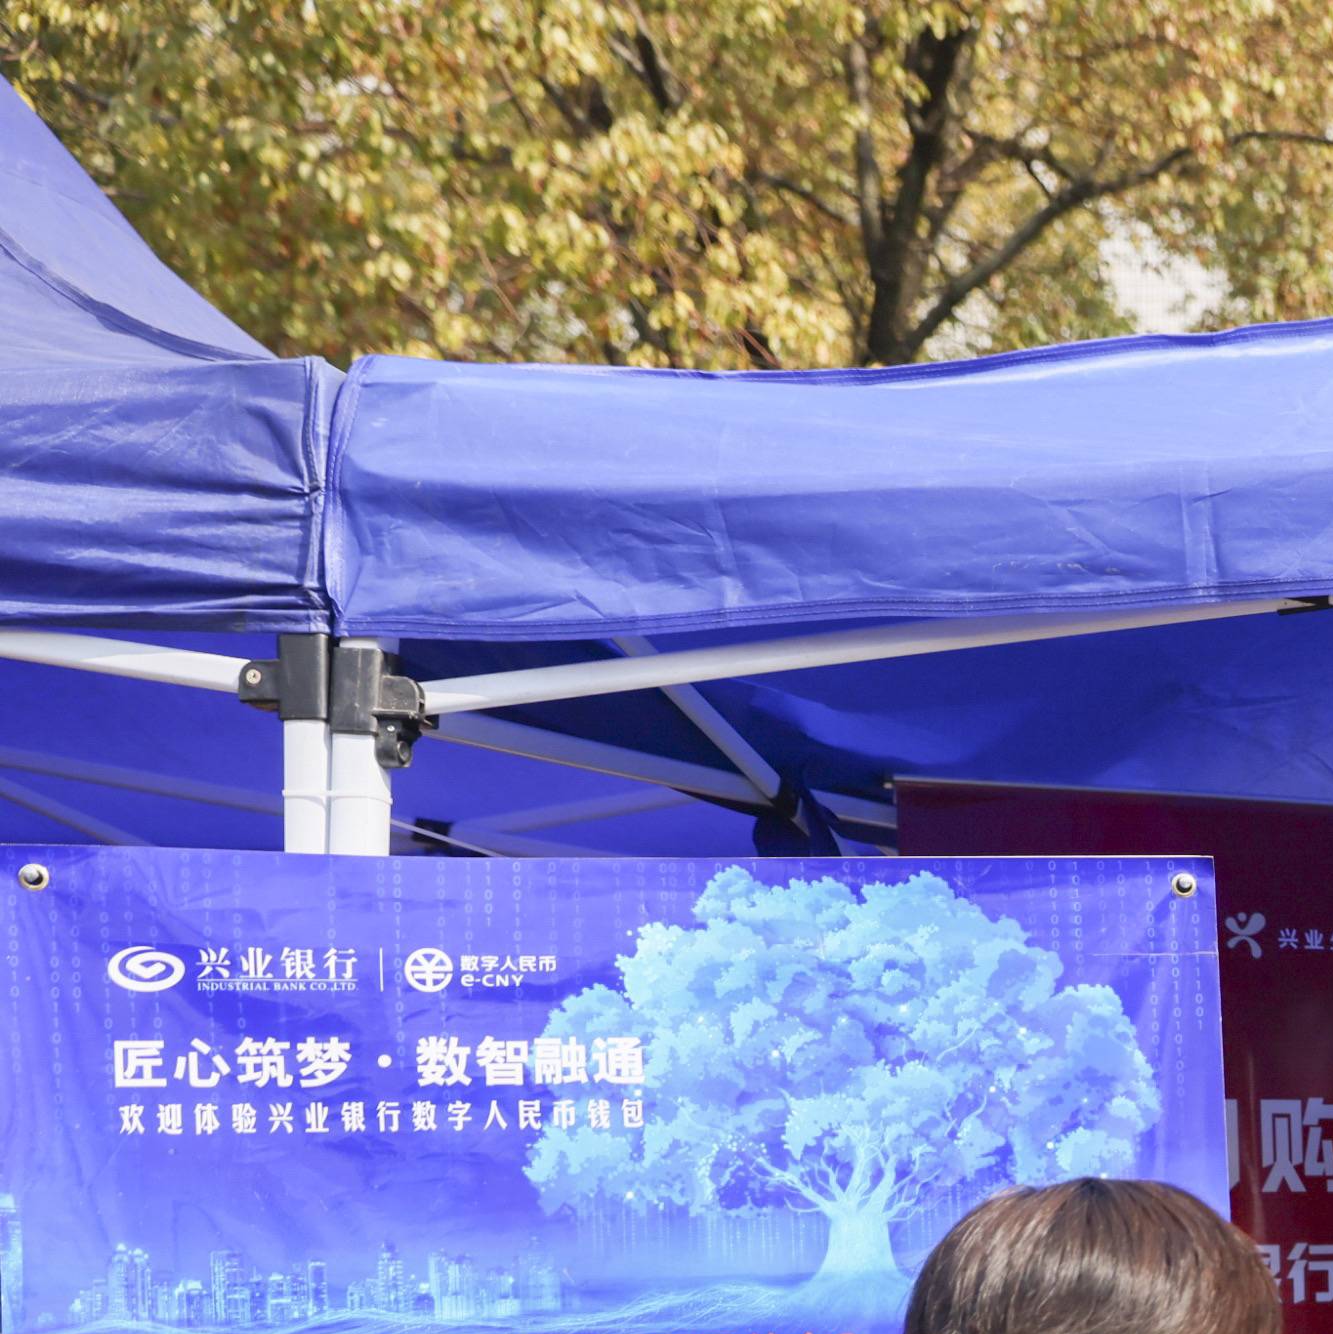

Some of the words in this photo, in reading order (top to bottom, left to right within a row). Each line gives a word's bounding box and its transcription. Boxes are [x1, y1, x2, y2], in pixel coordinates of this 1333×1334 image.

[195, 946, 358, 979] 兴业银行
[460, 954, 557, 972] 数字人民币
[197, 981, 270, 992] INDUSTRIAL
[274, 981, 306, 992] BANK
[460, 974, 525, 988] e-CNY
[119, 1099, 645, 1135] 欢迎体验兴业银行数字人民币钱包
